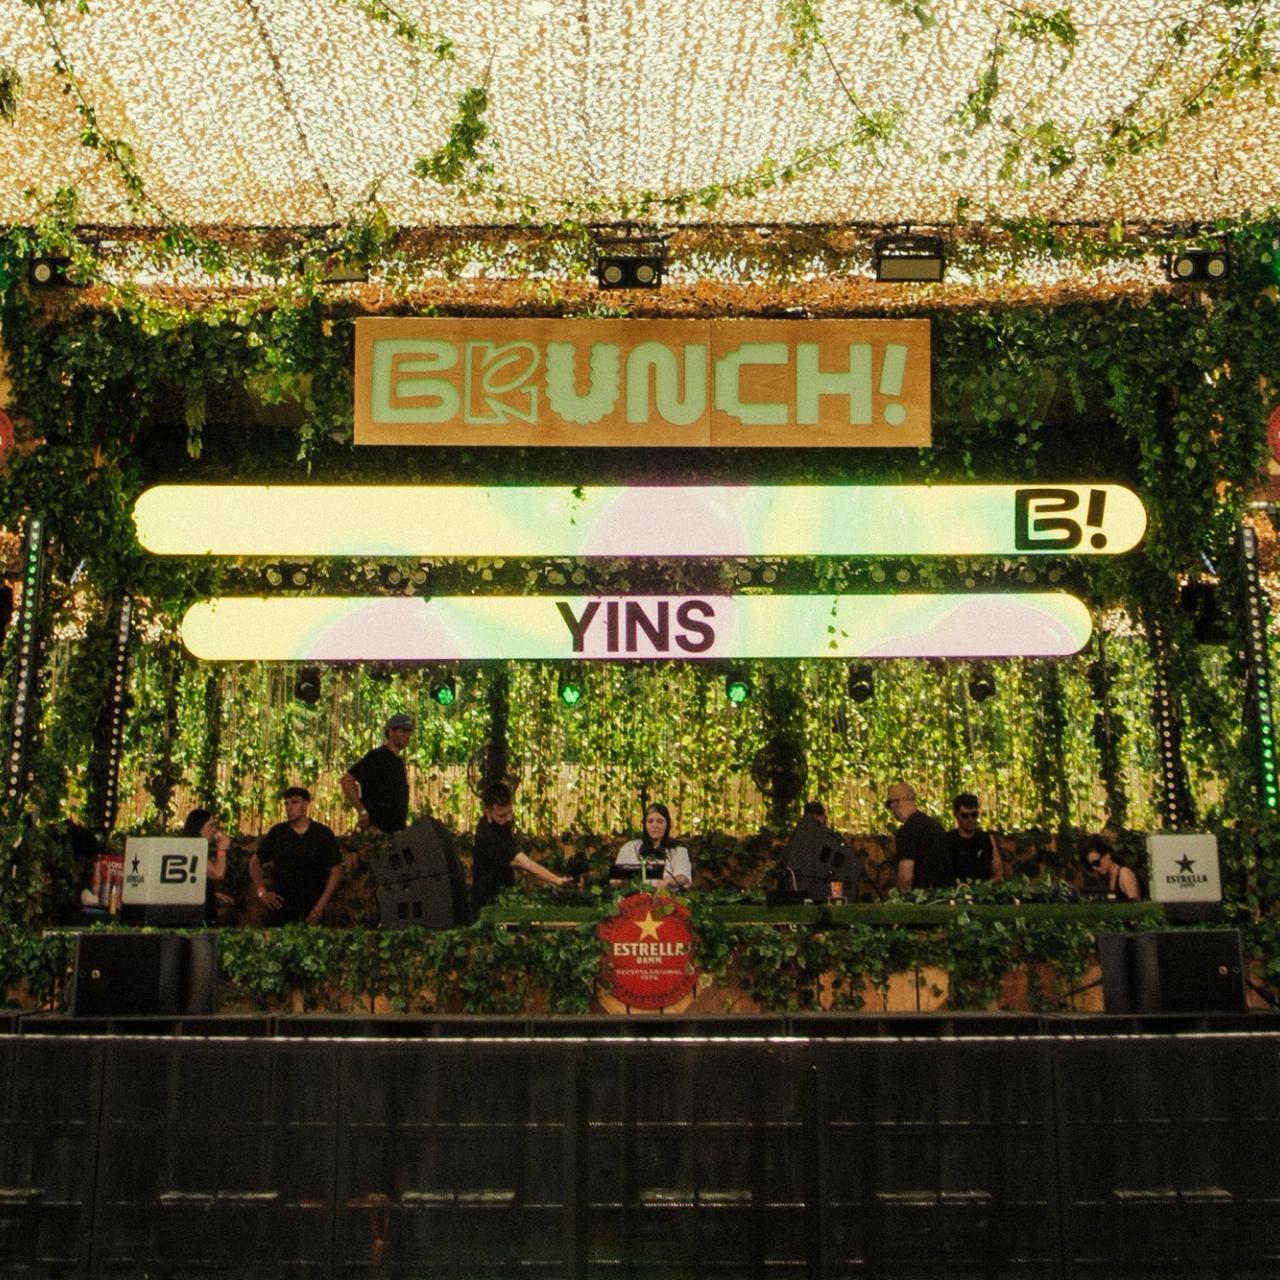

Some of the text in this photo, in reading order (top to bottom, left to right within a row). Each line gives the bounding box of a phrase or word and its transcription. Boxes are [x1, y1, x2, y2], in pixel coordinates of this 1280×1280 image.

[371, 338, 908, 426] BRUNCH!
[1014, 488, 1107, 551] B!
[556, 599, 716, 653] YINS
[160, 855, 199, 884] B!
[1166, 874, 1208, 884] ESTRELLA
[637, 956, 662, 965] DAMM
